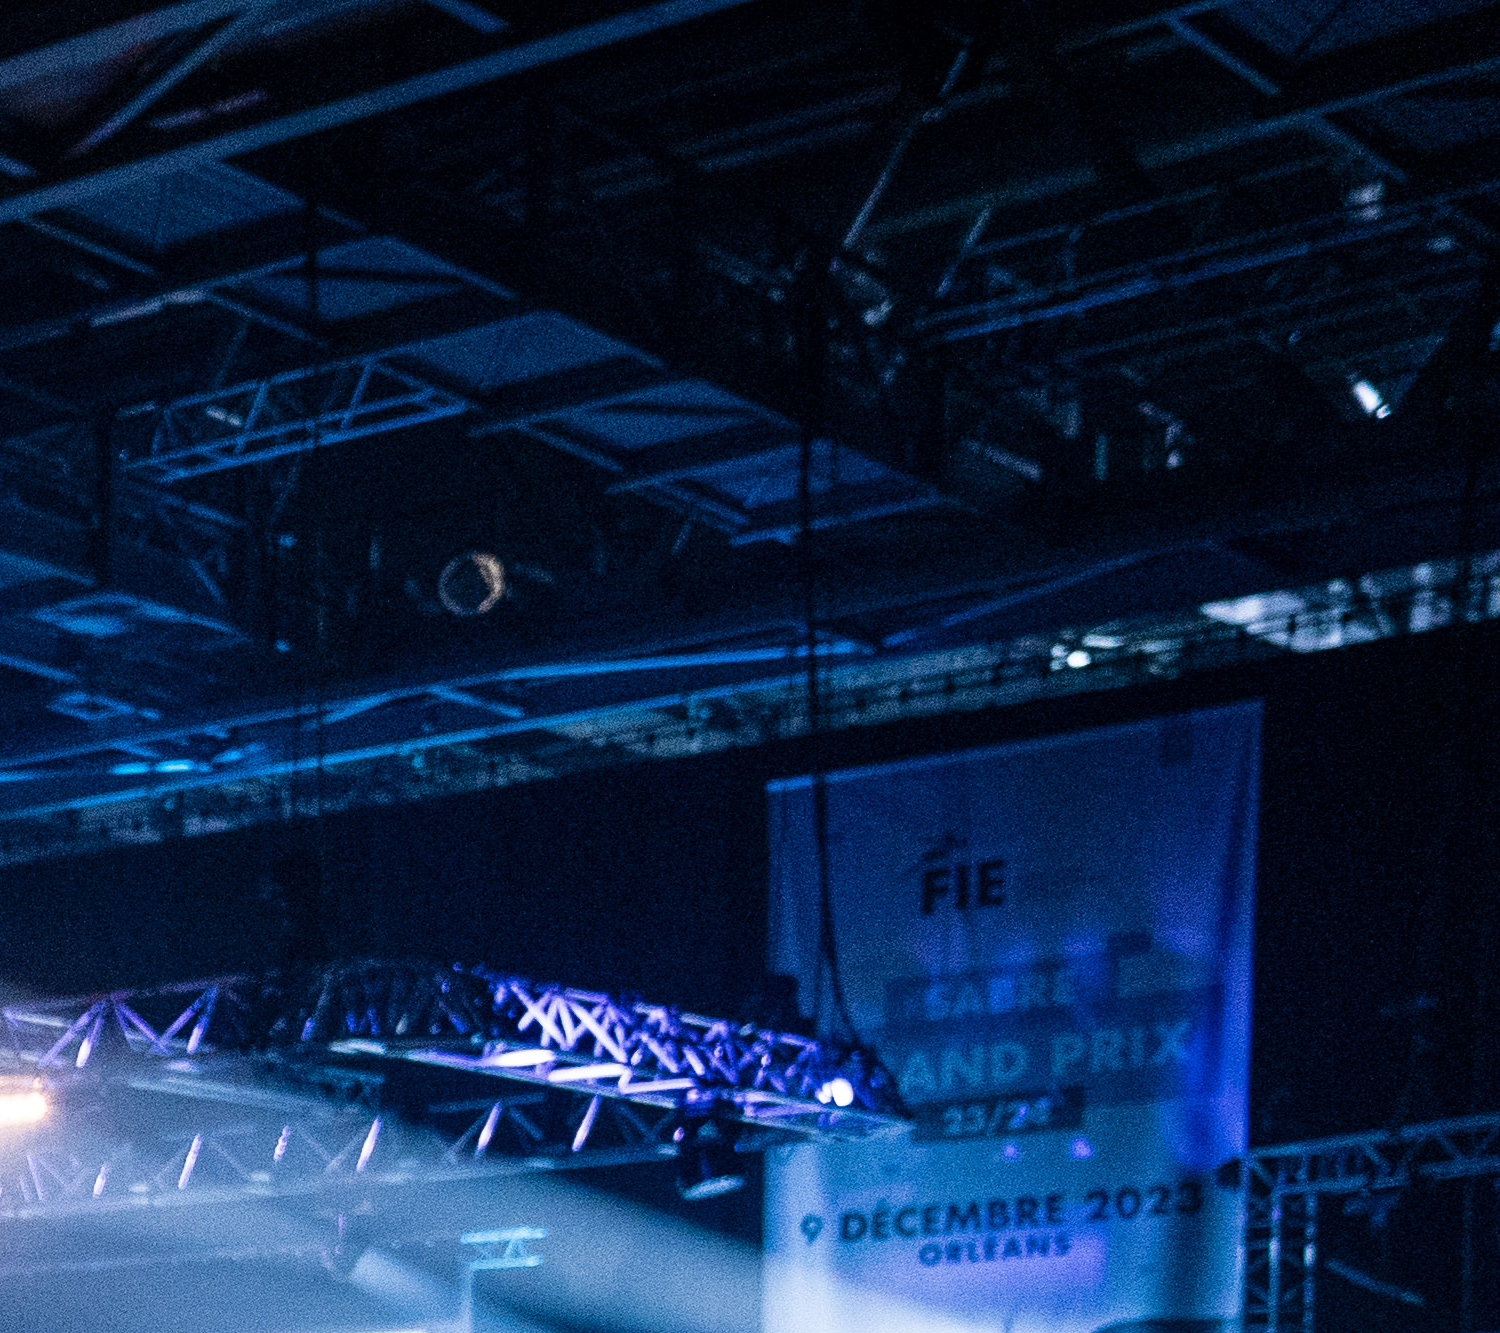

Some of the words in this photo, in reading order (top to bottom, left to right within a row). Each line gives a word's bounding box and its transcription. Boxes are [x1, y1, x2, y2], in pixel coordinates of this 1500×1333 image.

[921, 857, 1005, 915] FIE
[888, 1038, 1029, 1095] AND
[1049, 1018, 1190, 1078] PRIX
[799, 1212, 823, 1246] 9
[839, 1194, 1066, 1243] DÉCEMBRE
[1085, 1178, 1206, 1225] 2023
[918, 1233, 1073, 1267] ORLÉANS
